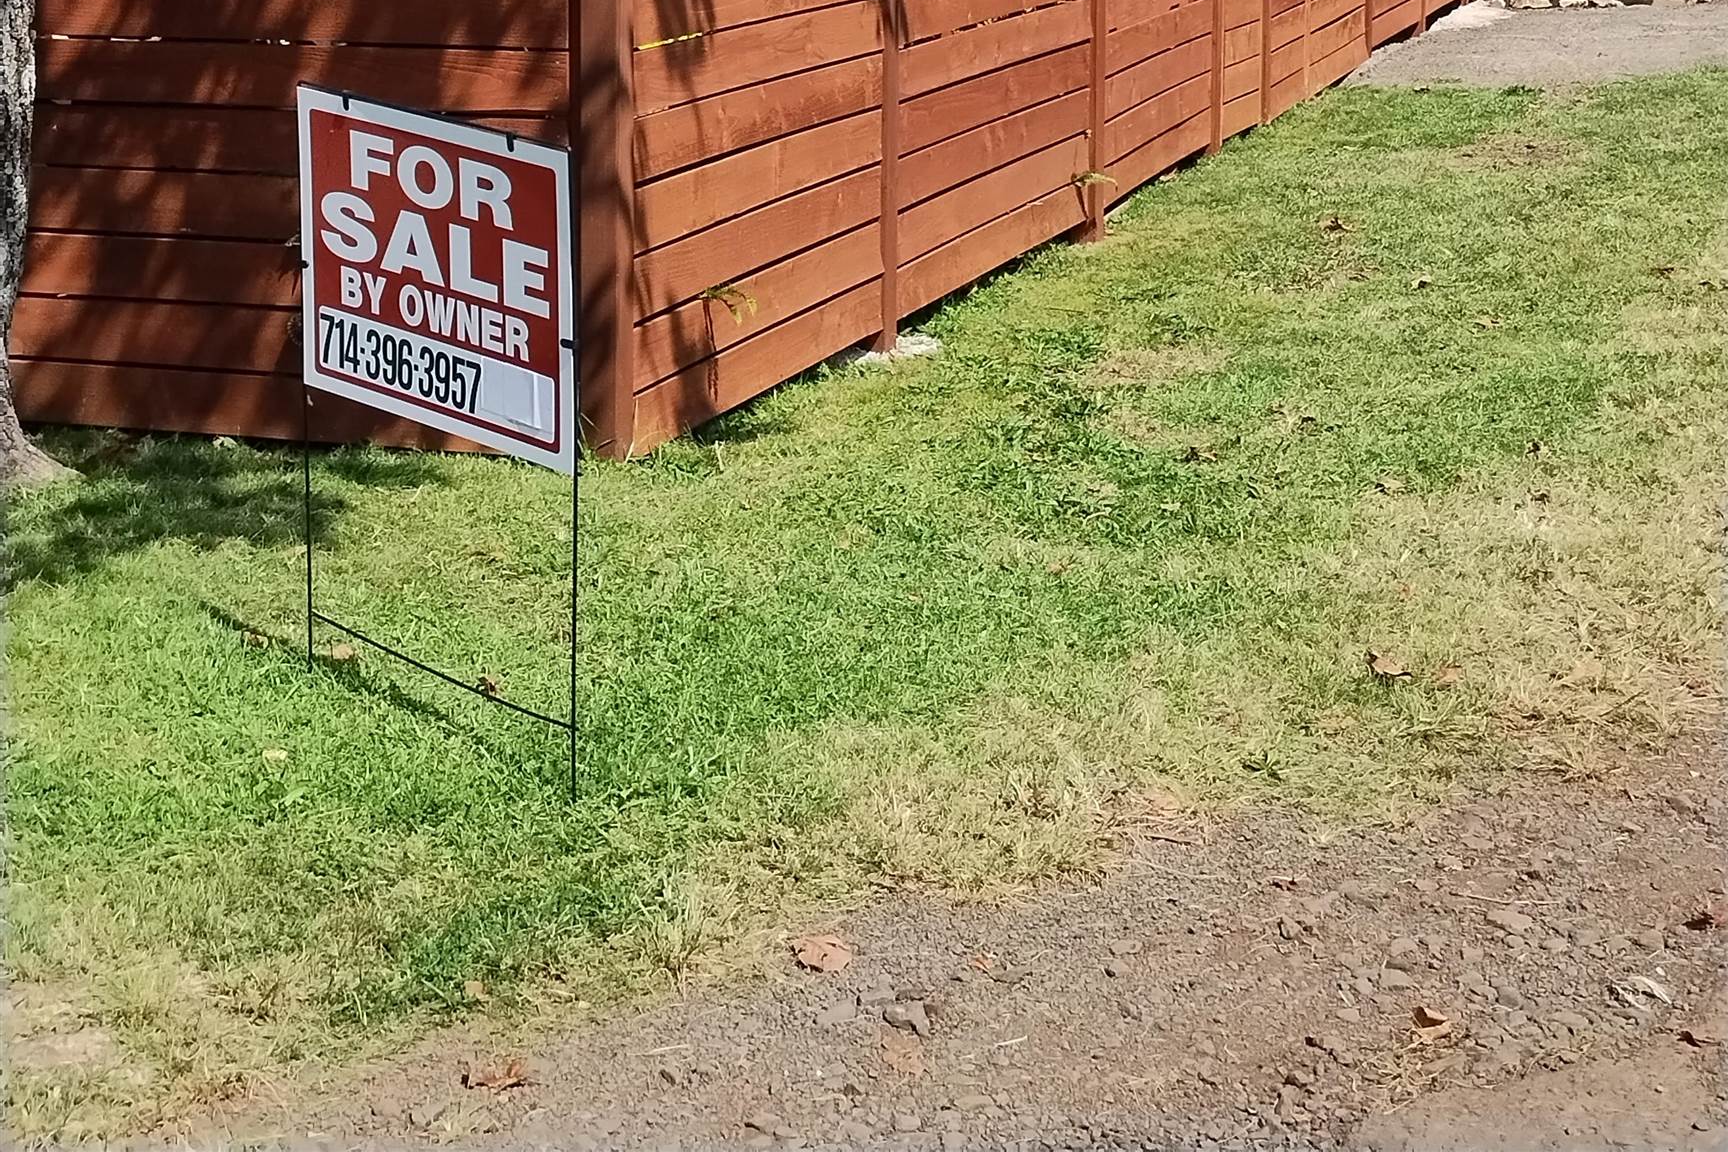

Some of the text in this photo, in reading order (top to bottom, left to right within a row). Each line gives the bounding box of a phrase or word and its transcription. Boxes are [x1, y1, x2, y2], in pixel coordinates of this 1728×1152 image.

[349, 129, 514, 231] FOR
[320, 191, 550, 320] SALE
[319, 313, 481, 414] 714-396-3957
[340, 265, 530, 362] BY OWNER
